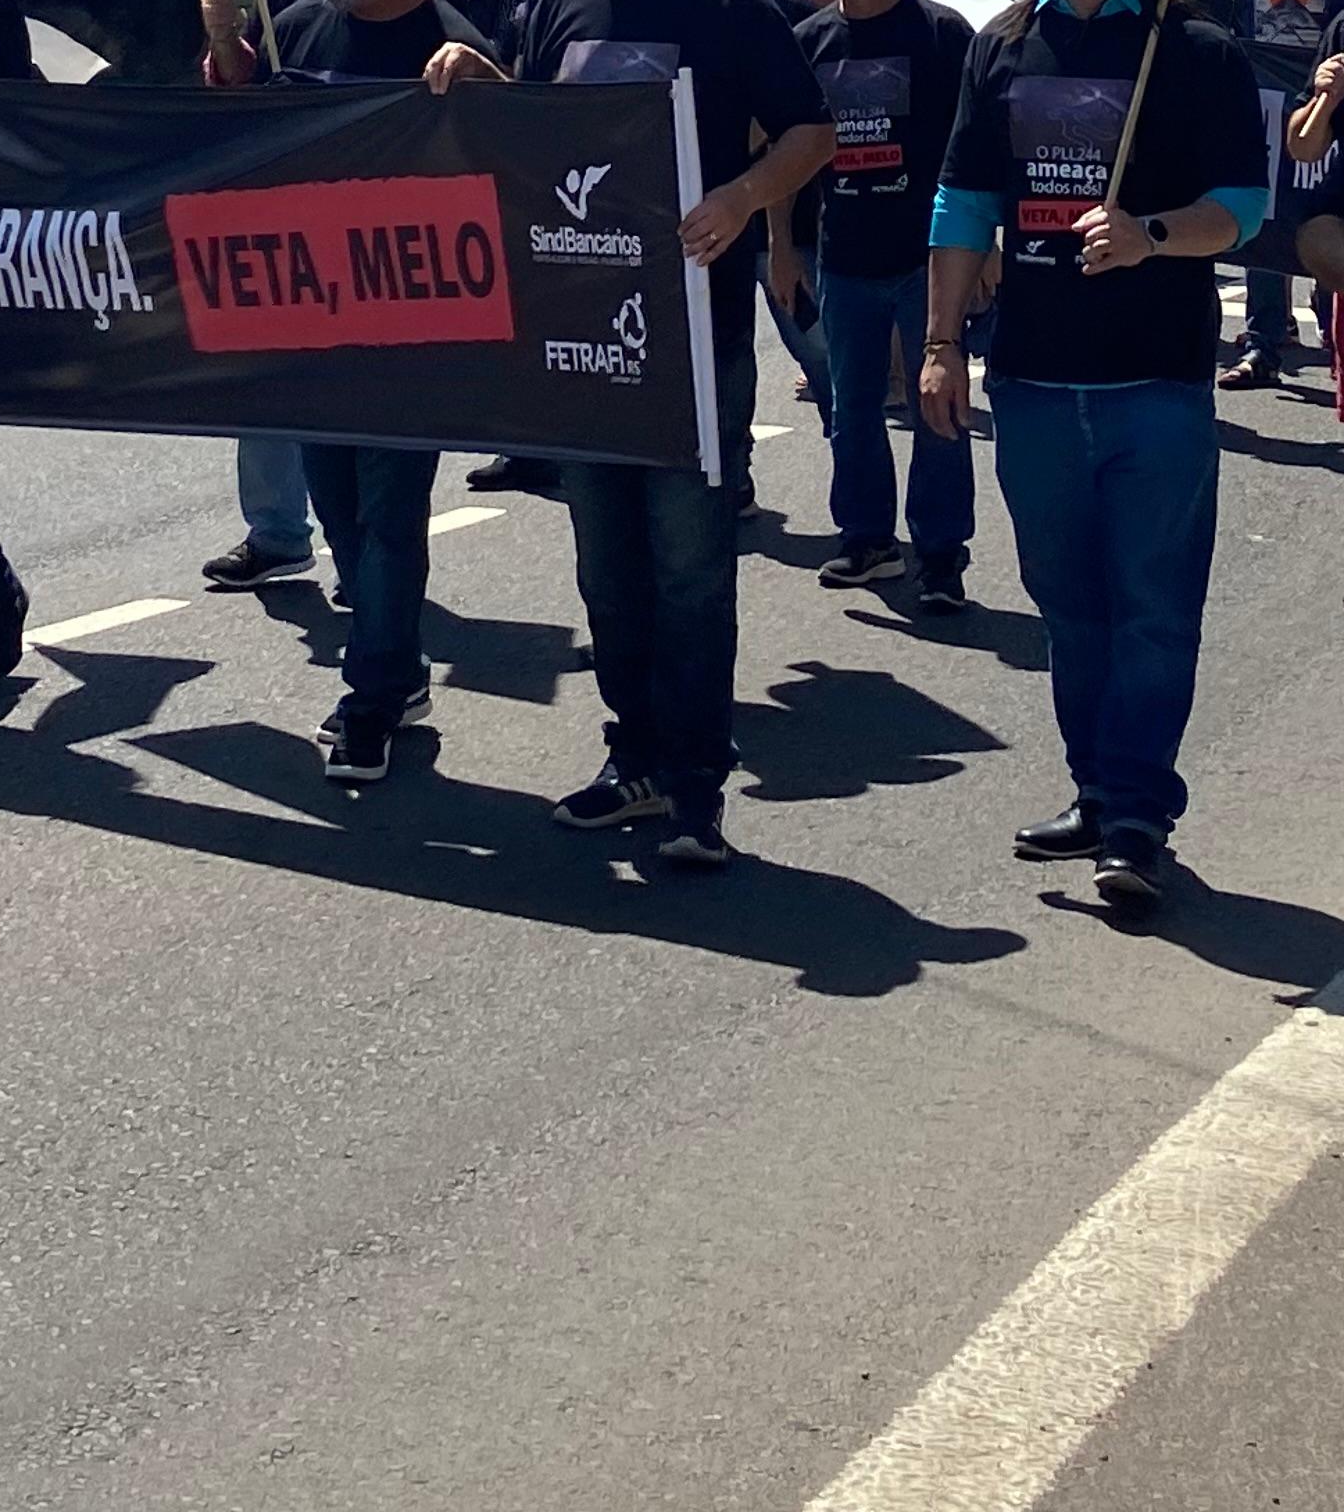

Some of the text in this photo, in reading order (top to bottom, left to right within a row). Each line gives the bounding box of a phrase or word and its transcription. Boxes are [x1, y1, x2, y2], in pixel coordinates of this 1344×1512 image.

[1036, 145, 1101, 161] O PLL244
[1026, 162, 1108, 185] ameaça
[1031, 179, 1103, 197] todos nós!
[1021, 208, 1065, 226] VETA,
[530, 224, 643, 256] SindBancários
[184, 221, 496, 315] VETA, MELO
[545, 340, 626, 375] FETRAFI
